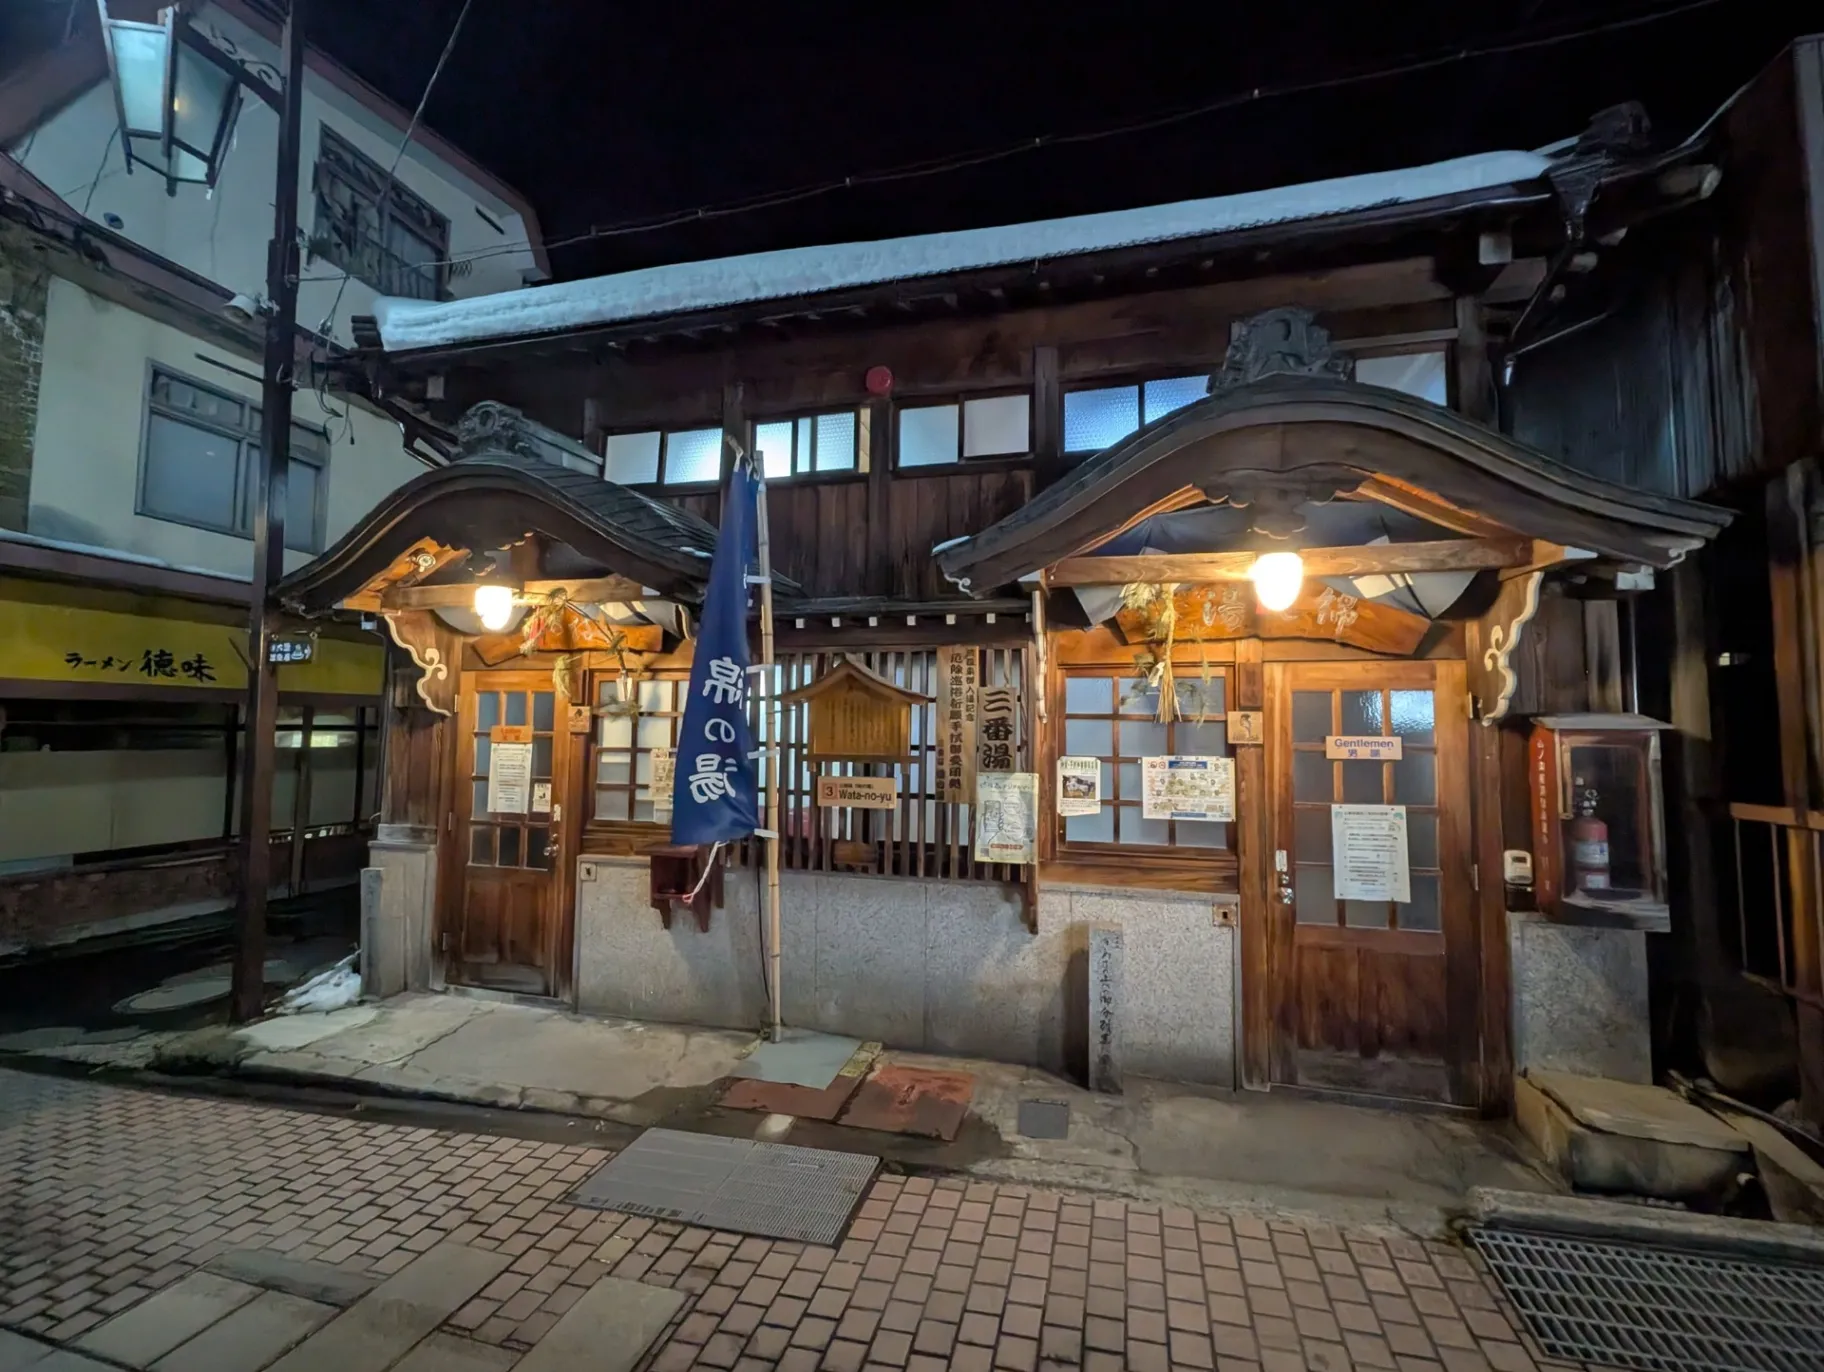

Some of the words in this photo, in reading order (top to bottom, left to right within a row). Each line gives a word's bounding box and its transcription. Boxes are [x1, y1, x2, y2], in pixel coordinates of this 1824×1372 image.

[65, 652, 133, 672] ラーメン
[982, 690, 1013, 769] 三番湯
[1334, 738, 1394, 748] Gentlemen
[825, 786, 834, 797] 3
[839, 789, 892, 804] Wata-no-yu
